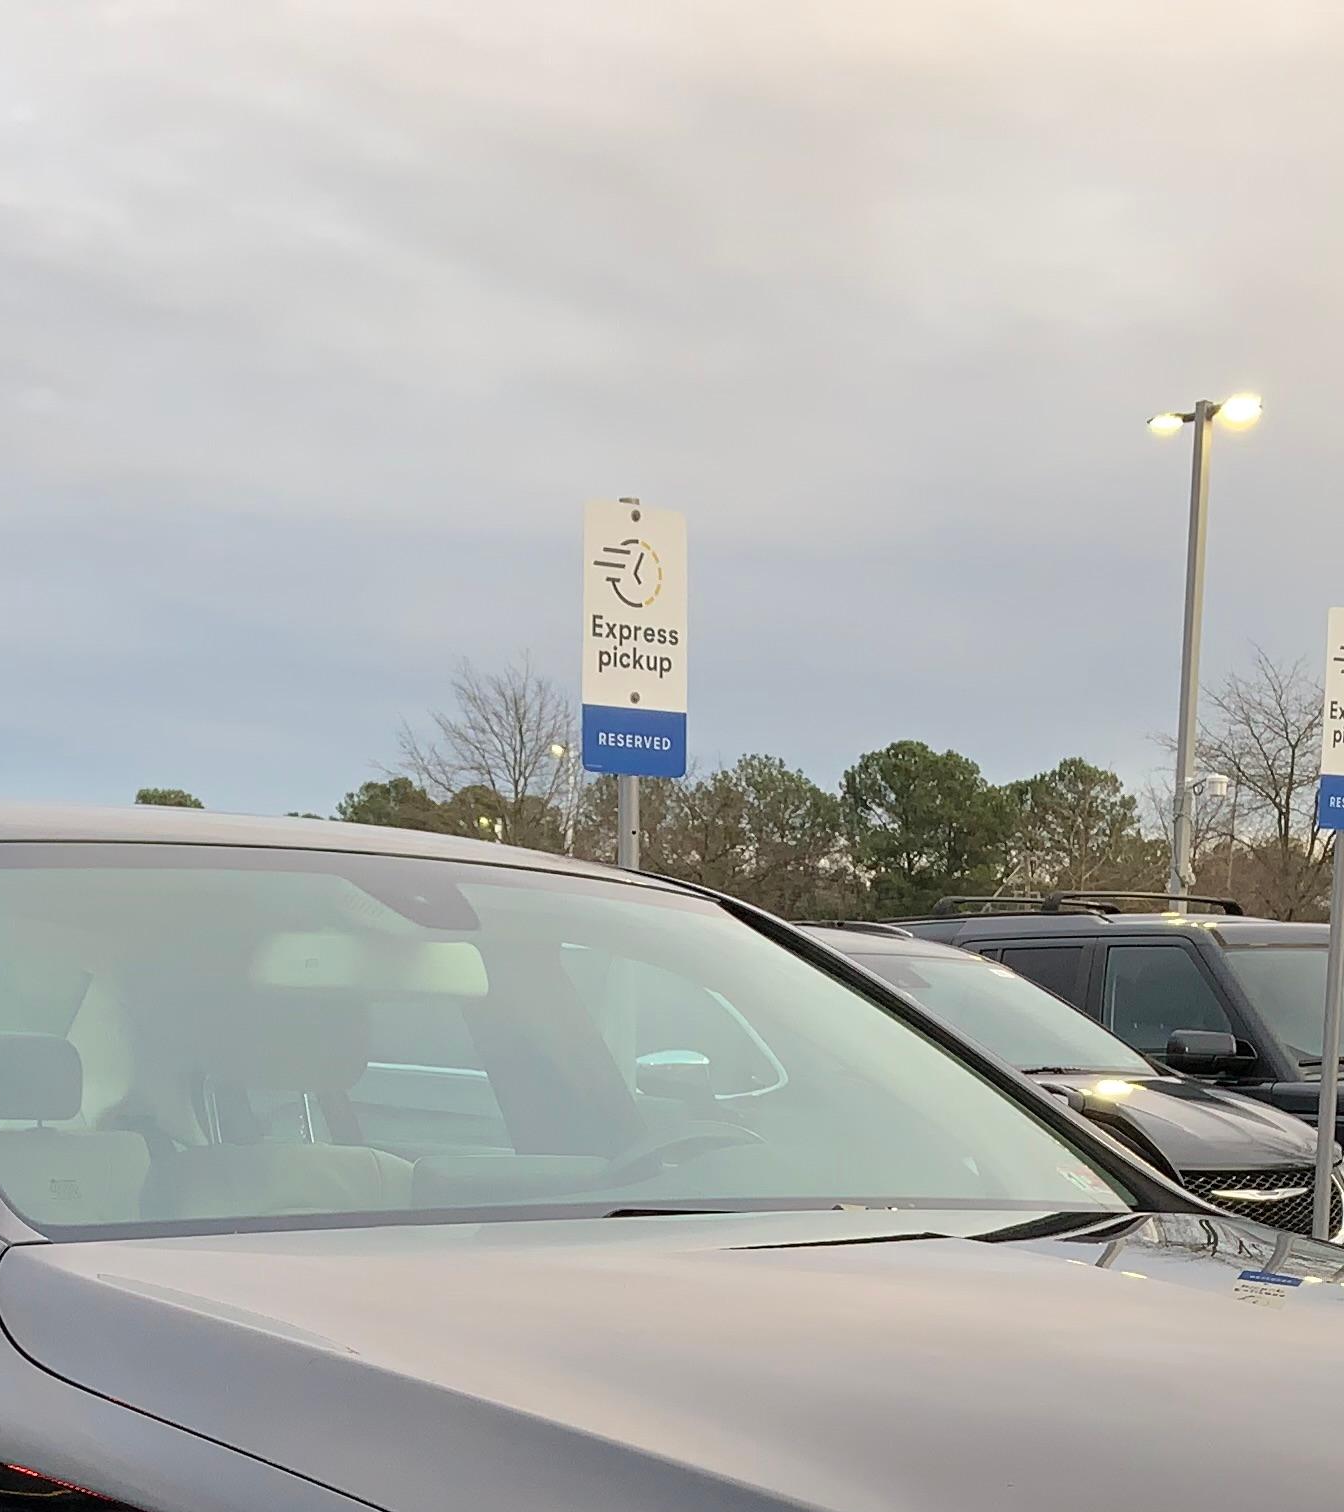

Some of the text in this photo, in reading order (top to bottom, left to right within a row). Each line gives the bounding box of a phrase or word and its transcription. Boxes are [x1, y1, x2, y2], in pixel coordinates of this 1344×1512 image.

[591, 614, 679, 646] Express
[598, 647, 673, 679] pickup
[598, 732, 672, 751] RESERVED
